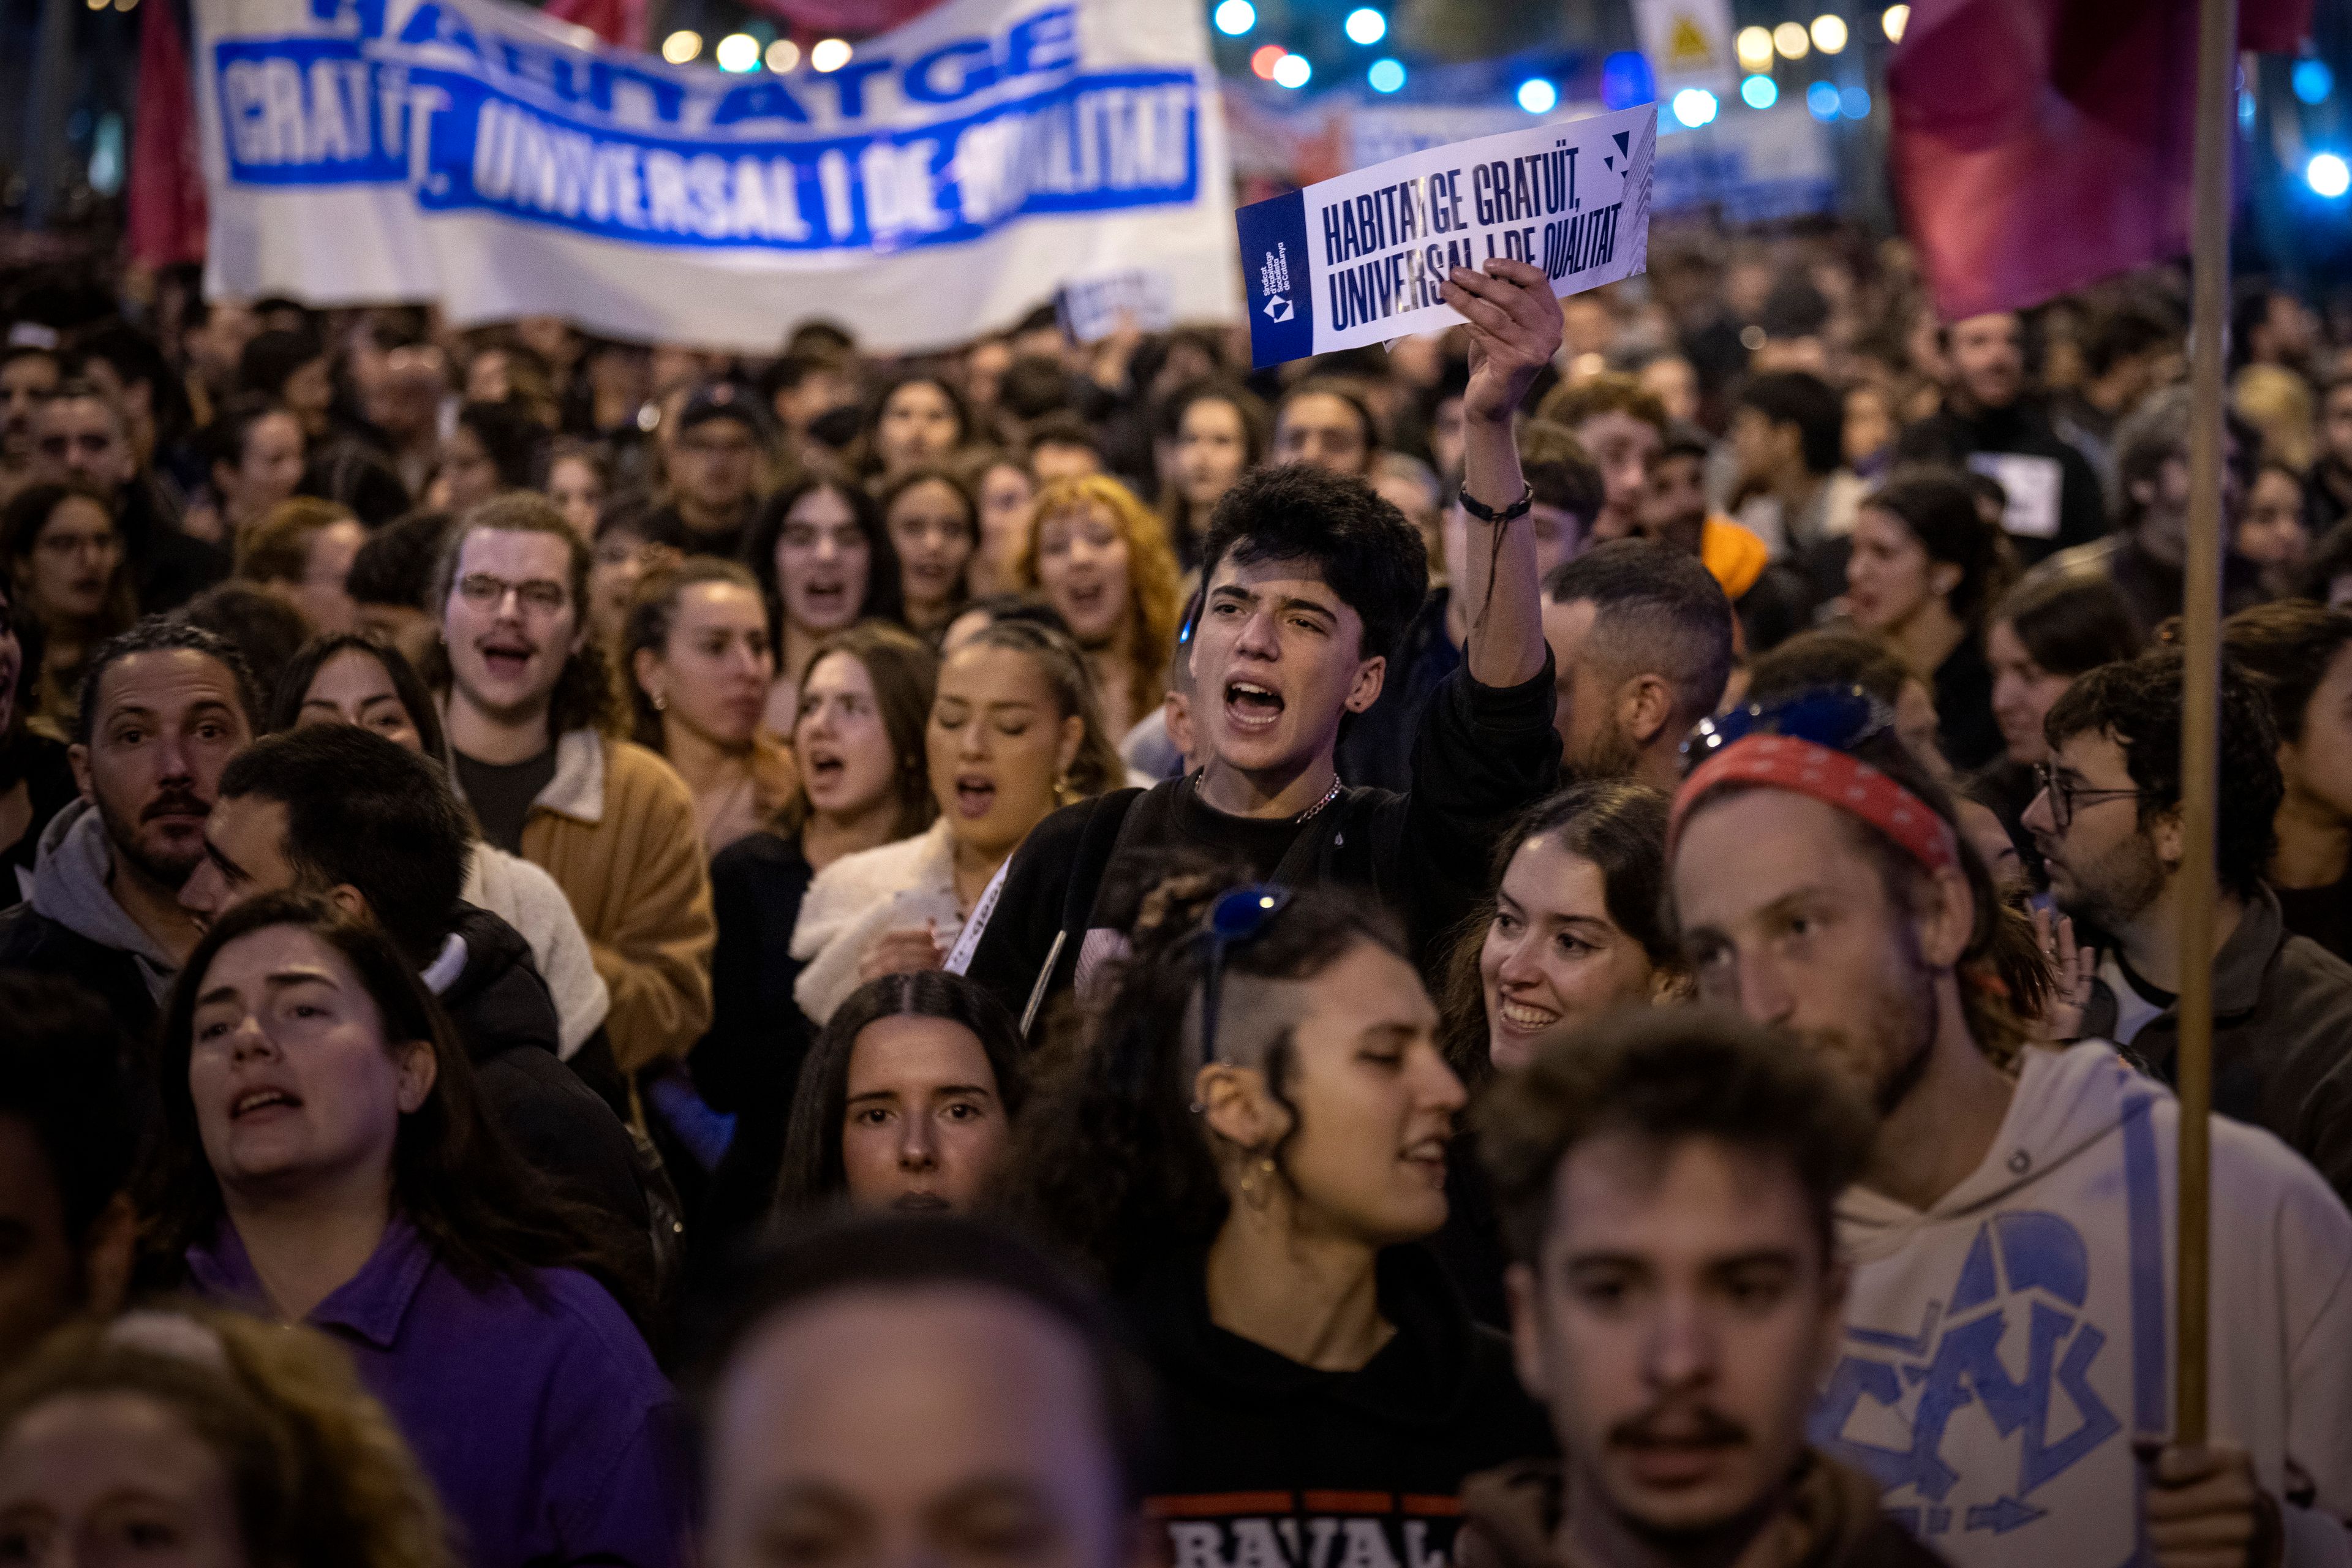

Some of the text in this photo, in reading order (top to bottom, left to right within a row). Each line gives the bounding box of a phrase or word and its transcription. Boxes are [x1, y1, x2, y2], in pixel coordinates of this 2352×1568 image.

[1321, 138, 1580, 267] HABITATGE GRATUÏT,
[1261, 266, 1270, 296] Sindicat
[1273, 258, 1284, 293] Socialista
[1278, 241, 1290, 291] de Catalunya
